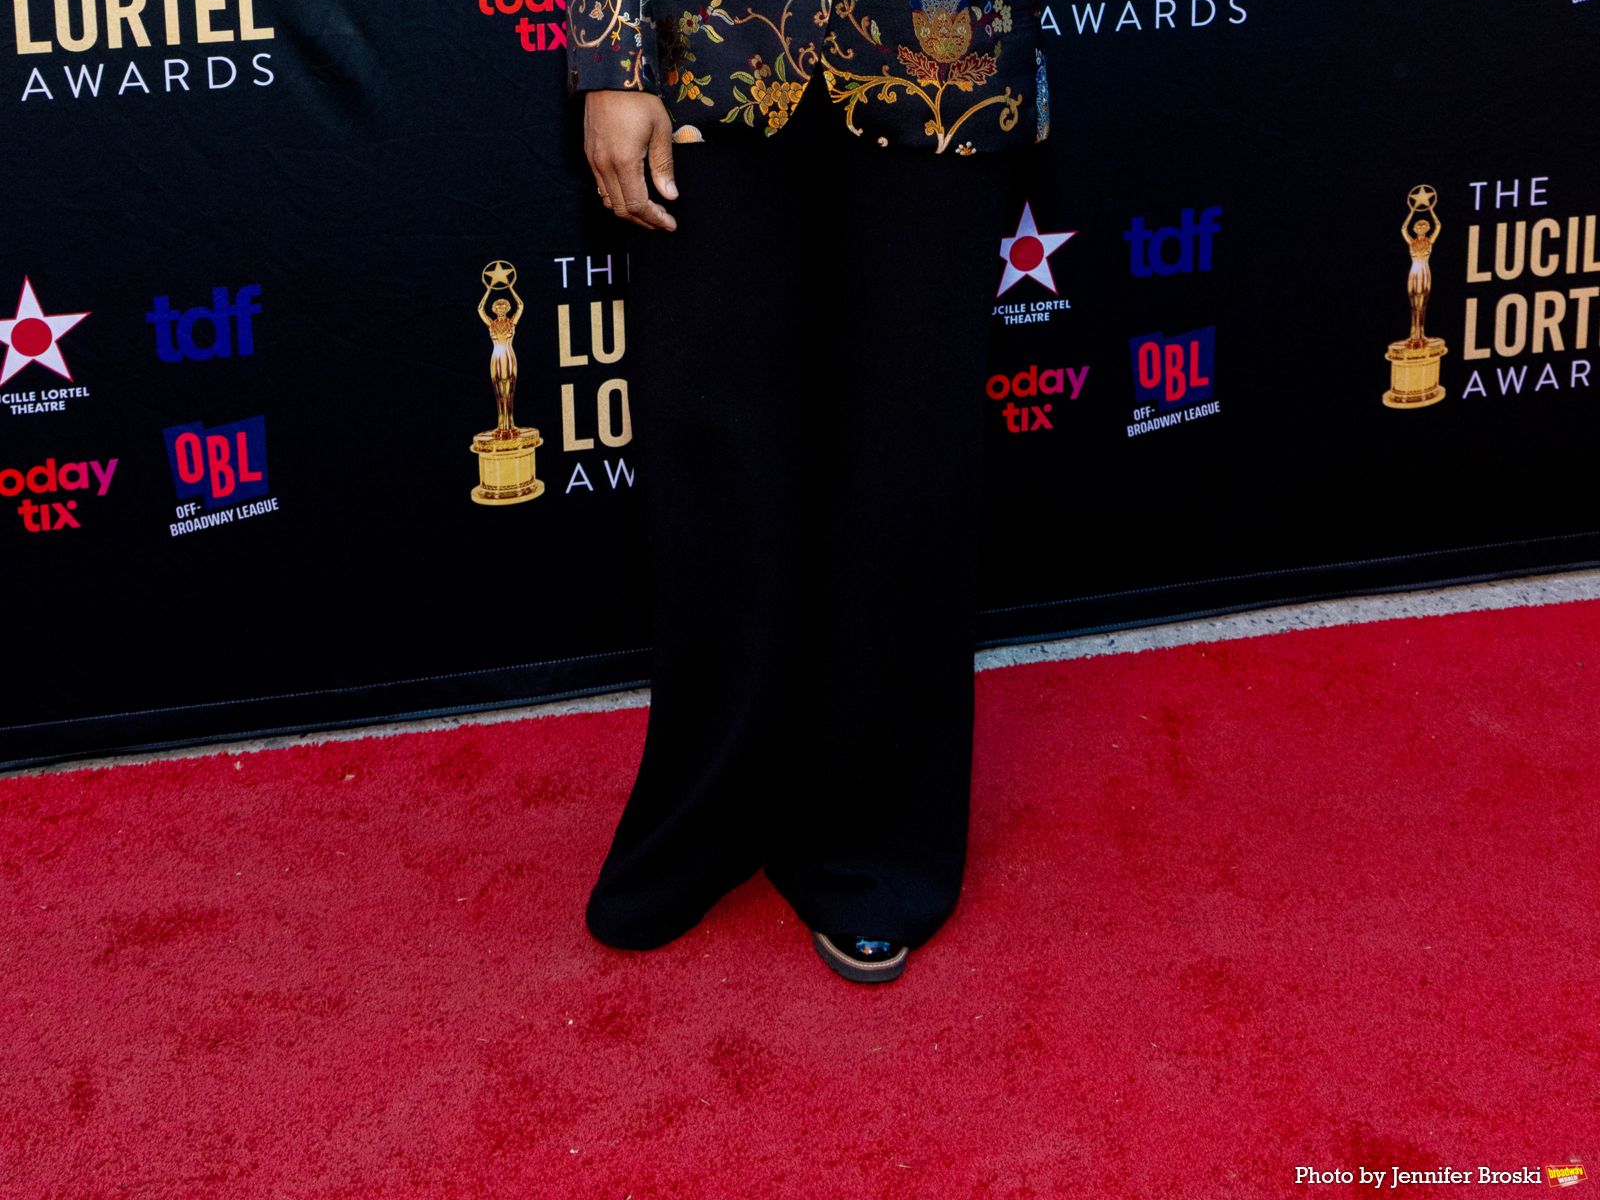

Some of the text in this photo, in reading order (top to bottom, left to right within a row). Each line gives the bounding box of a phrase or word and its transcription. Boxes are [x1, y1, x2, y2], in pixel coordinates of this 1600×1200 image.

[21, 53, 275, 101] AWARDS
[1470, 177, 1548, 210] THE
[1124, 206, 1222, 277] tdf
[1467, 215, 1600, 282] LUCIL
[554, 253, 629, 288] TH
[146, 285, 261, 362] tdf
[1004, 312, 1050, 325] THEATRE
[1031, 300, 1070, 311] LORTEL
[1463, 286, 1600, 361] LORT
[987, 365, 1088, 399] oday
[1139, 341, 1208, 401] OBL
[1462, 359, 1591, 399] AWAR
[0, 386, 90, 404] CILLE LORTEL
[10, 401, 66, 415] THEATRE
[1134, 405, 1155, 421] OFF-
[1003, 403, 1053, 432] tix
[1127, 400, 1221, 437] BROADWAY LEAGUE
[0, 458, 117, 496] oday
[176, 432, 262, 498] OBL
[18, 499, 80, 532] tix
[169, 497, 279, 537] BROADWAY LEAGUE
[176, 502, 201, 519] OFF-
